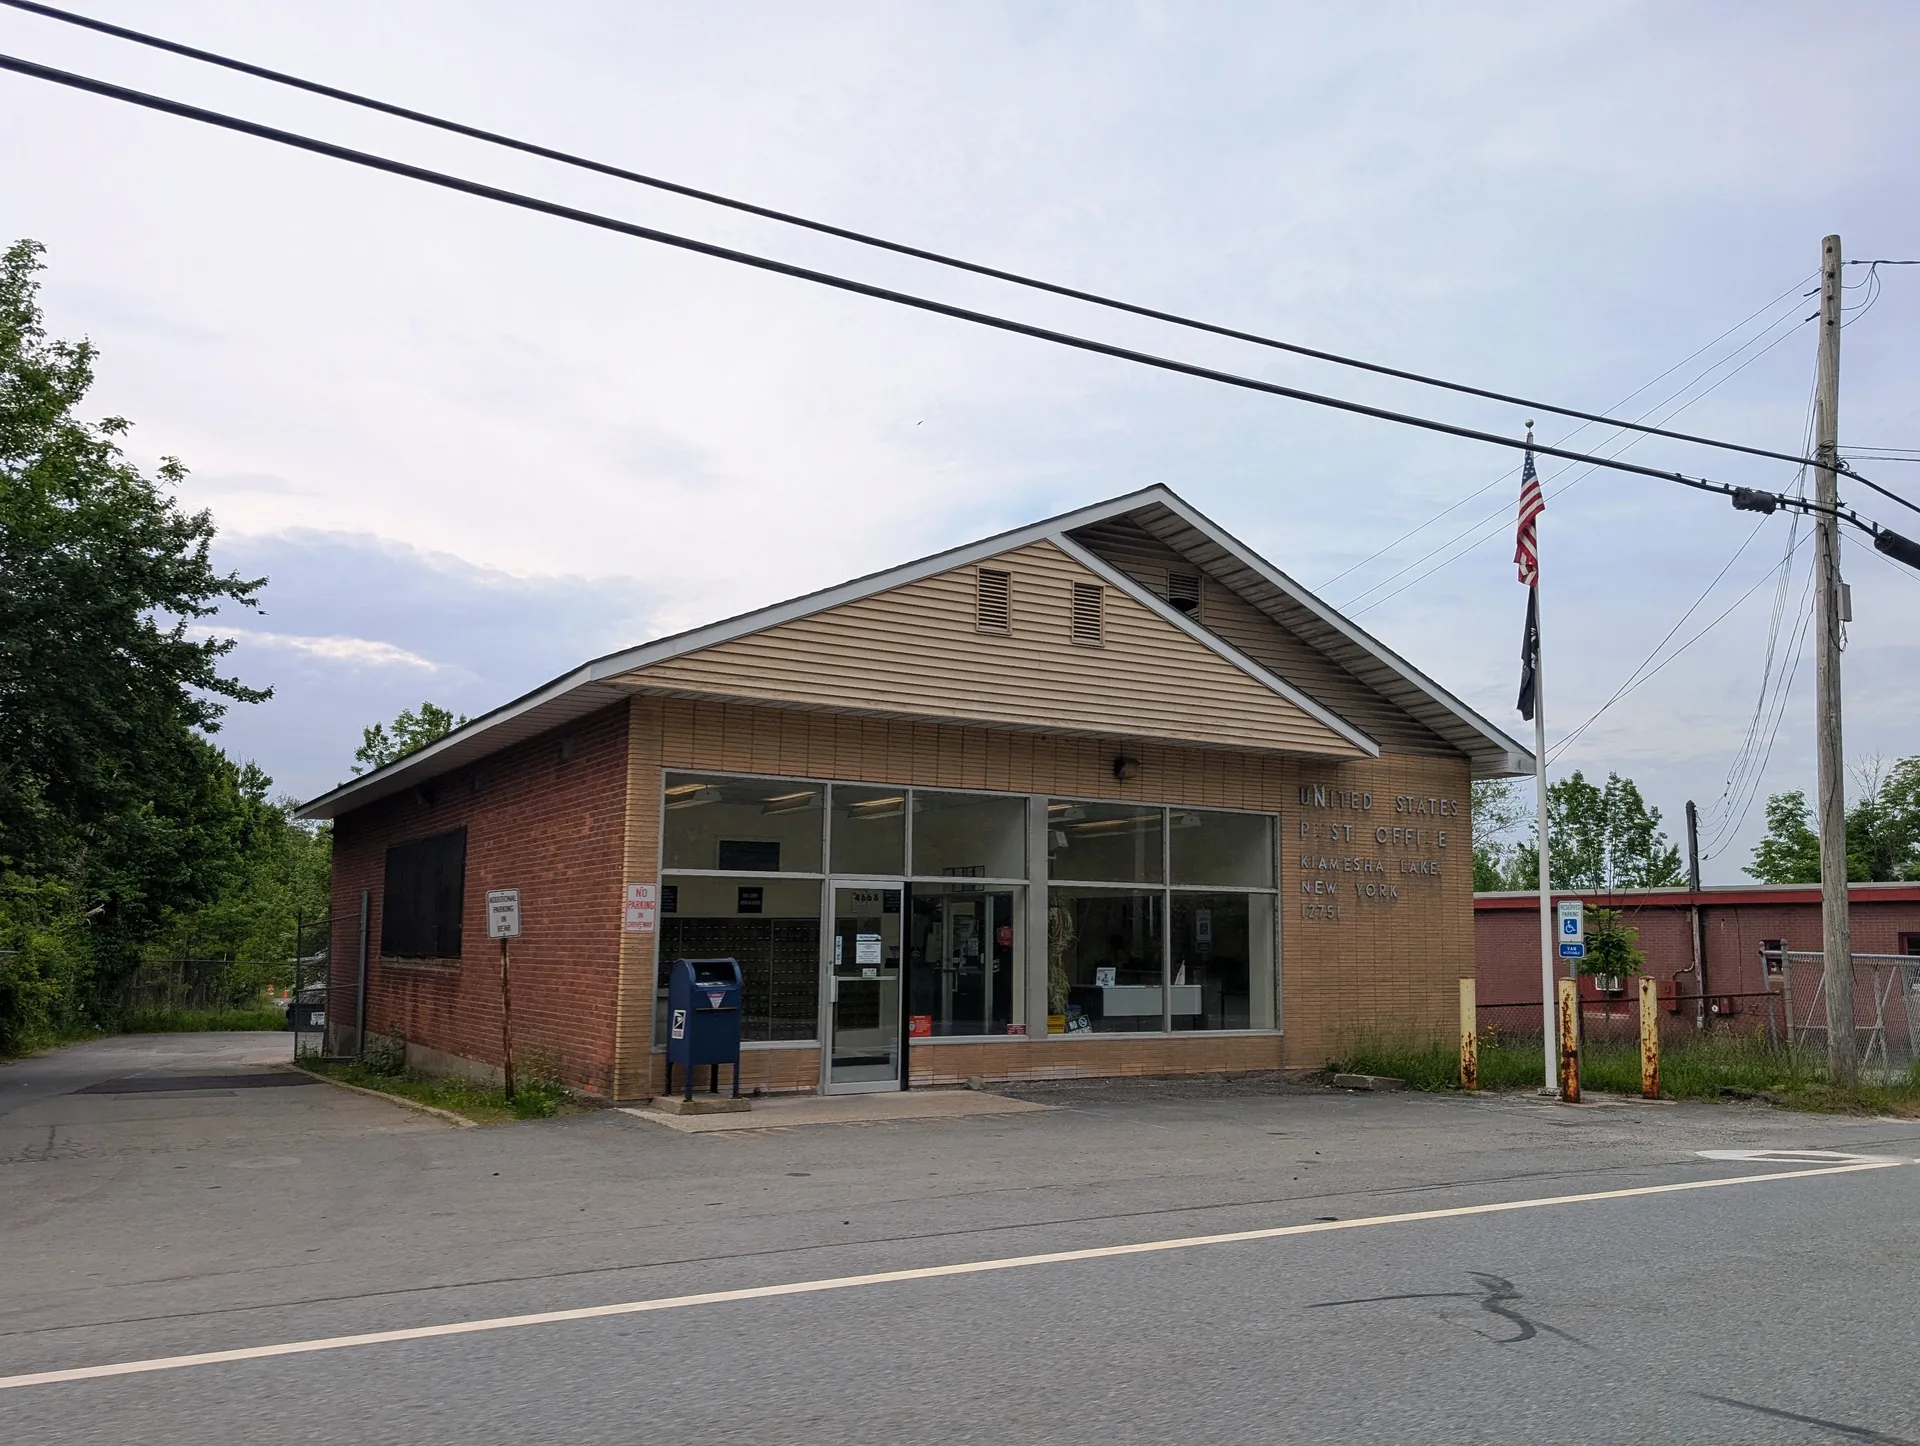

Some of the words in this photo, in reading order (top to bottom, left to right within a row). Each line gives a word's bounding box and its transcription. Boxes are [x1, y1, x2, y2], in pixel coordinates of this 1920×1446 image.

[1300, 784, 1373, 810] UNITED
[1396, 795, 1458, 817] STATES
[1301, 822, 1352, 843] PST
[1375, 826, 1447, 848] OFFIE
[1301, 855, 1384, 873] KIAMESHA
[635, 888, 648, 898] NO
[1301, 880, 1337, 895] NEW
[1355, 883, 1398, 899] YORK
[493, 905, 514, 913] PARKING
[628, 900, 656, 910] PARKING
[1302, 904, 1340, 920] 12751
